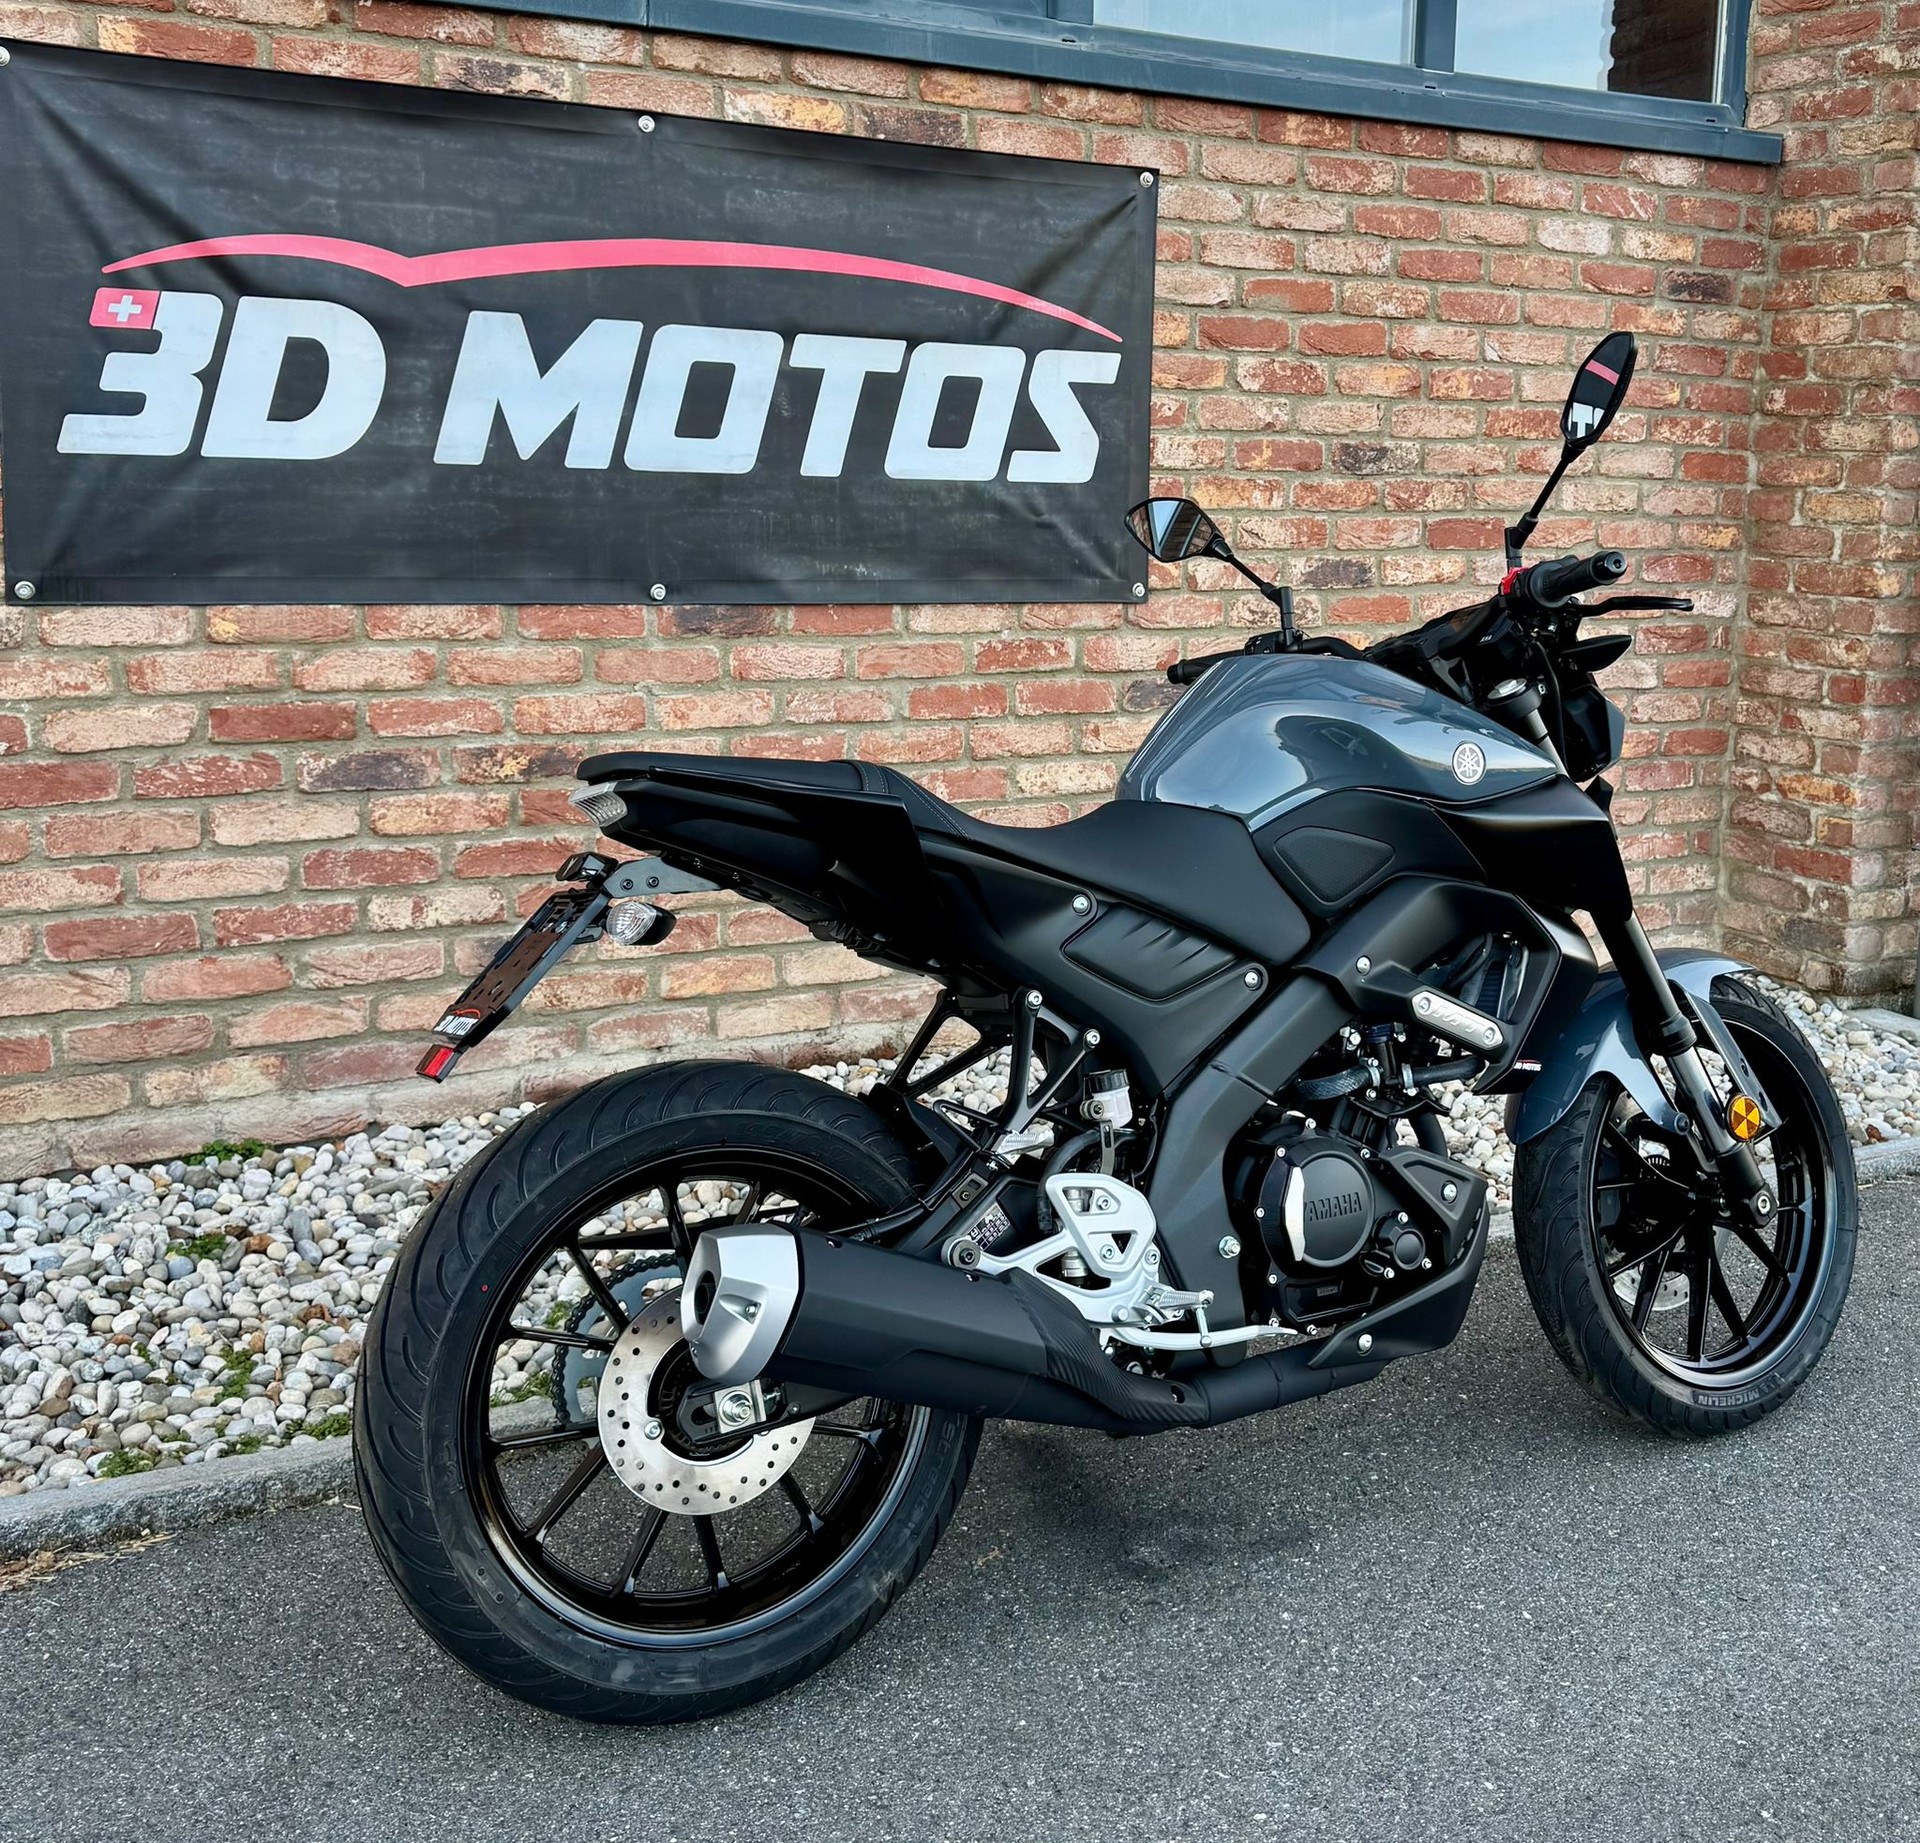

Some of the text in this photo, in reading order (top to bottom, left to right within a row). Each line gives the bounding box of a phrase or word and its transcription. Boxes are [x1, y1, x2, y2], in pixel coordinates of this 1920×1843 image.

[56, 288, 1122, 484] 3D MOTOS
[1698, 1389, 1760, 1407] MICHELIN
